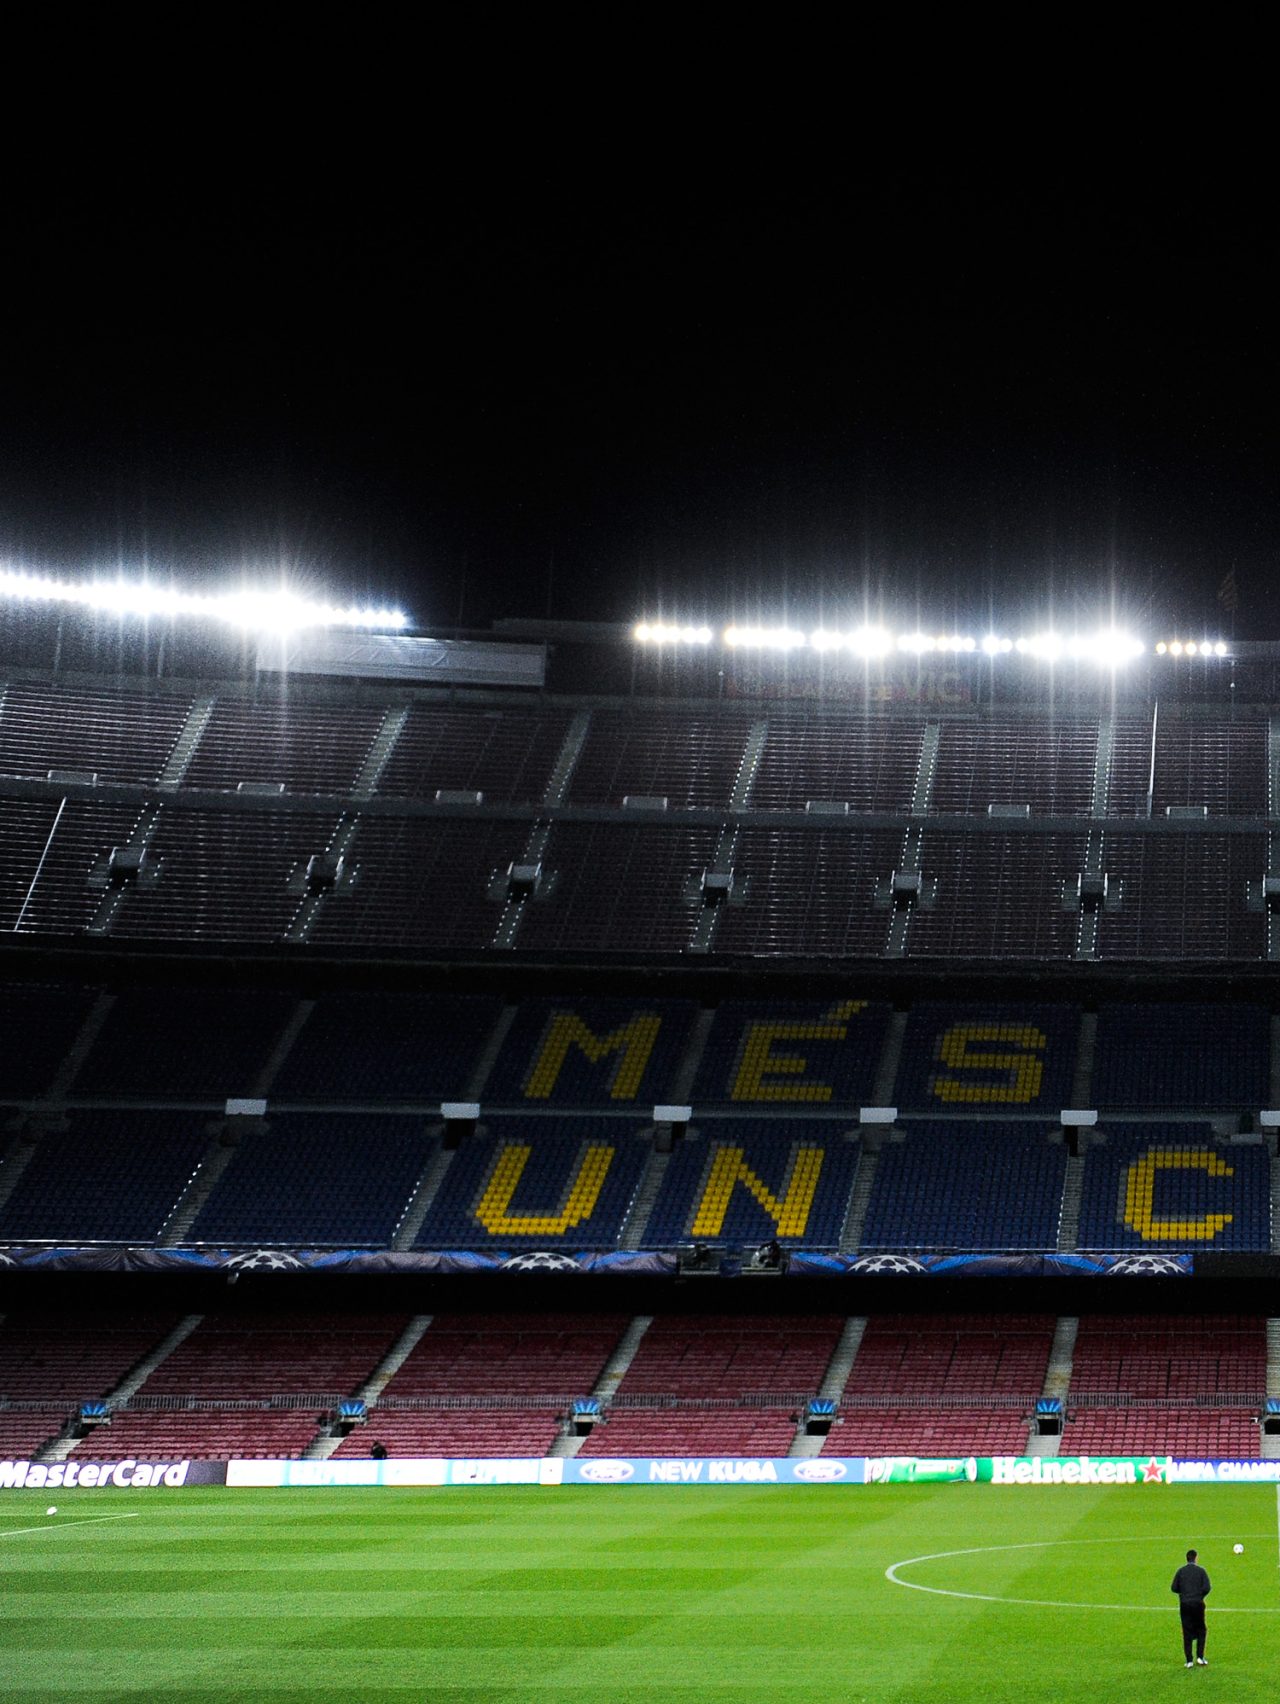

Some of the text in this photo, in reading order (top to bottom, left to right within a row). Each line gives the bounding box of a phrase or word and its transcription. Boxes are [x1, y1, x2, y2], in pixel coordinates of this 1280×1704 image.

[474, 1142, 824, 1236] UN
[0, 1460, 190, 1487] MasterCard
[649, 1461, 777, 1481] NEW KUGA
[991, 1457, 1137, 1483] Heineken
